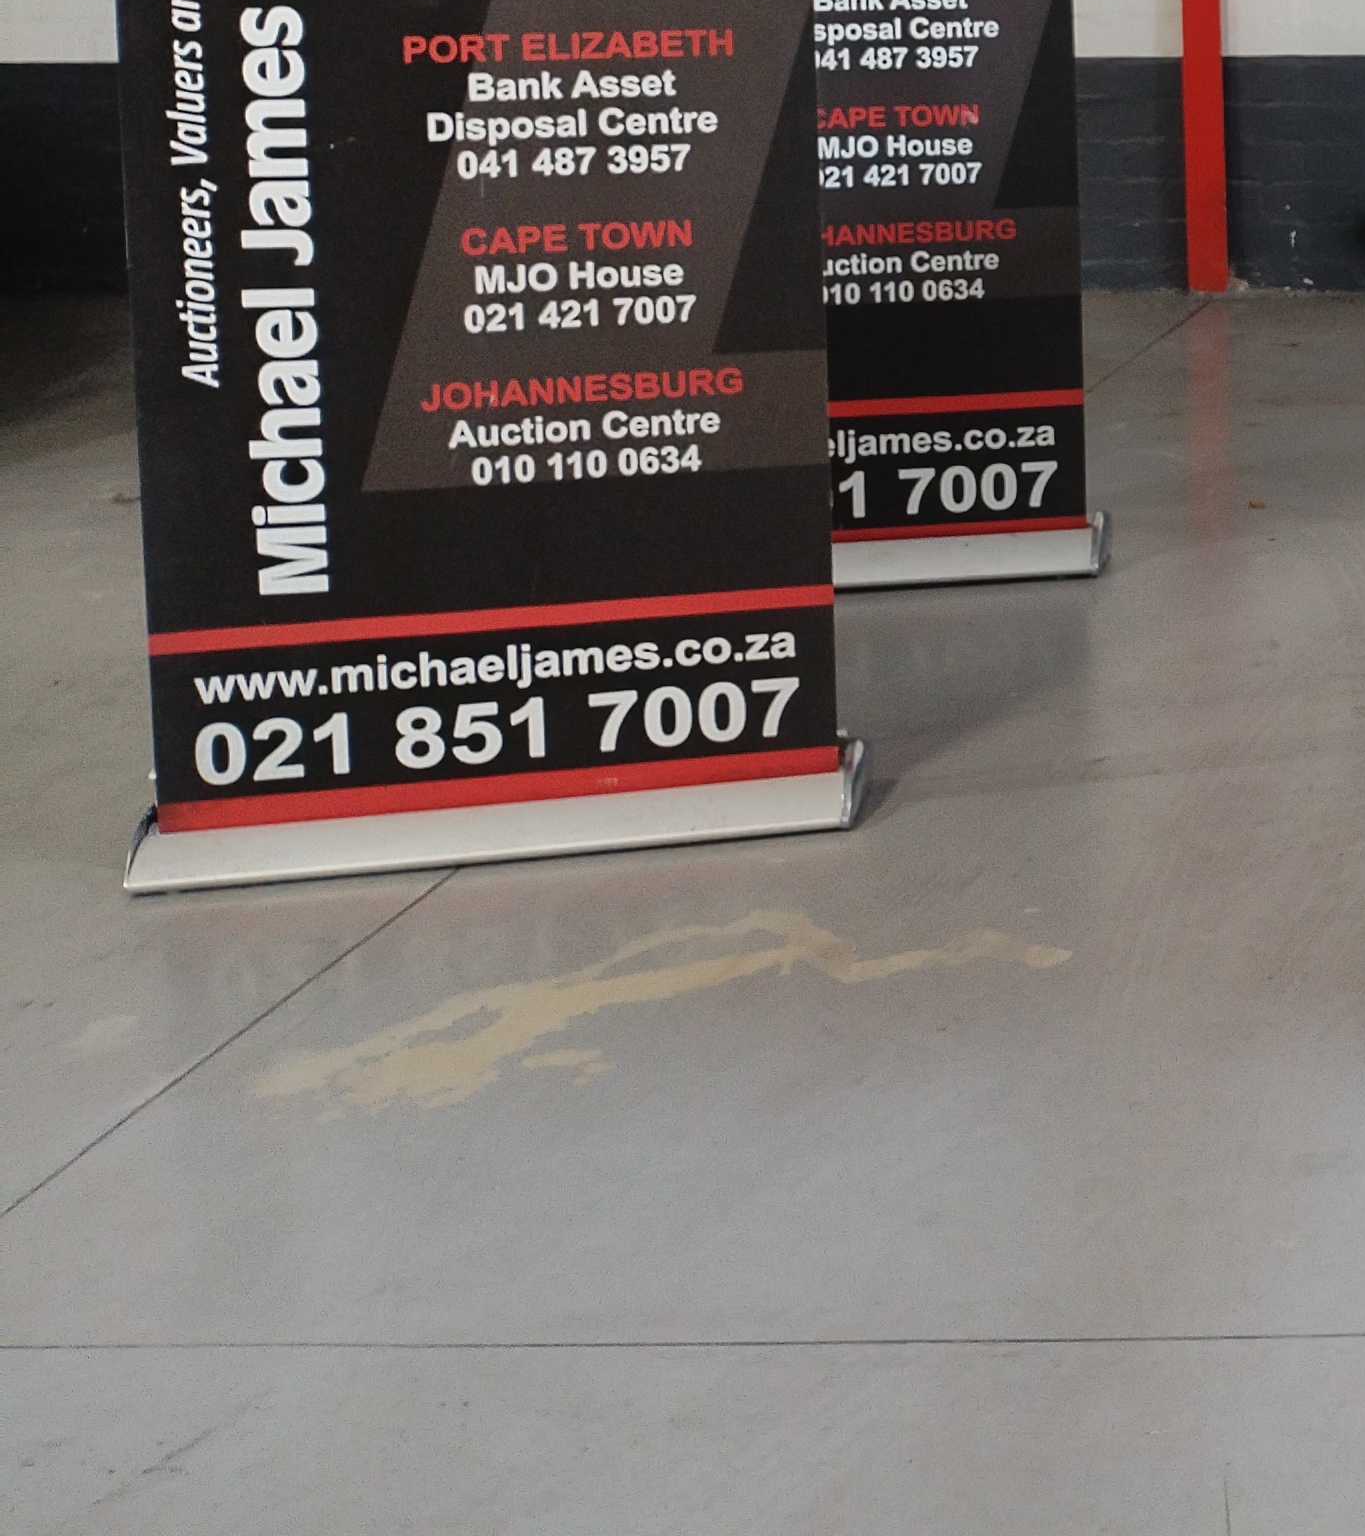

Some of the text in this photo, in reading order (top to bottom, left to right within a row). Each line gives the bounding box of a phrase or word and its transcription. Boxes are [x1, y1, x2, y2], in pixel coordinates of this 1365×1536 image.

[404, 29, 733, 63] PORT ELIZABETH
[814, 17, 999, 46] sposal Centre
[860, 47, 908, 69] 487
[917, 46, 978, 68] 3957
[166, 40, 208, 165] Valuers
[469, 70, 676, 101] Bank Asset
[427, 107, 718, 146] Disposal Centre
[894, 104, 978, 126] TOWN
[240, 6, 314, 265] James
[818, 135, 972, 159] MJO House
[457, 144, 690, 179] 041 487 3957
[864, 164, 908, 186] 421
[919, 162, 982, 185] 7007
[461, 220, 692, 255] CAPE TOWN
[821, 218, 1016, 246] HANNESBURG
[475, 261, 684, 294] MJO House
[823, 251, 999, 276] uction Centre
[176, 179, 219, 388] Auctioneers,
[870, 281, 914, 303] 110
[922, 278, 984, 301] 0634
[464, 295, 696, 333] 021 421 7007
[421, 368, 743, 412] JOHANNESBURG
[241, 288, 329, 595] Michael
[449, 409, 720, 449] Auction Centre
[472, 444, 702, 485] 010 110 0634
[898, 461, 1057, 514] 7007
[193, 628, 798, 706] www.michaeljames.co.za
[195, 677, 799, 785] 021 851 7007
